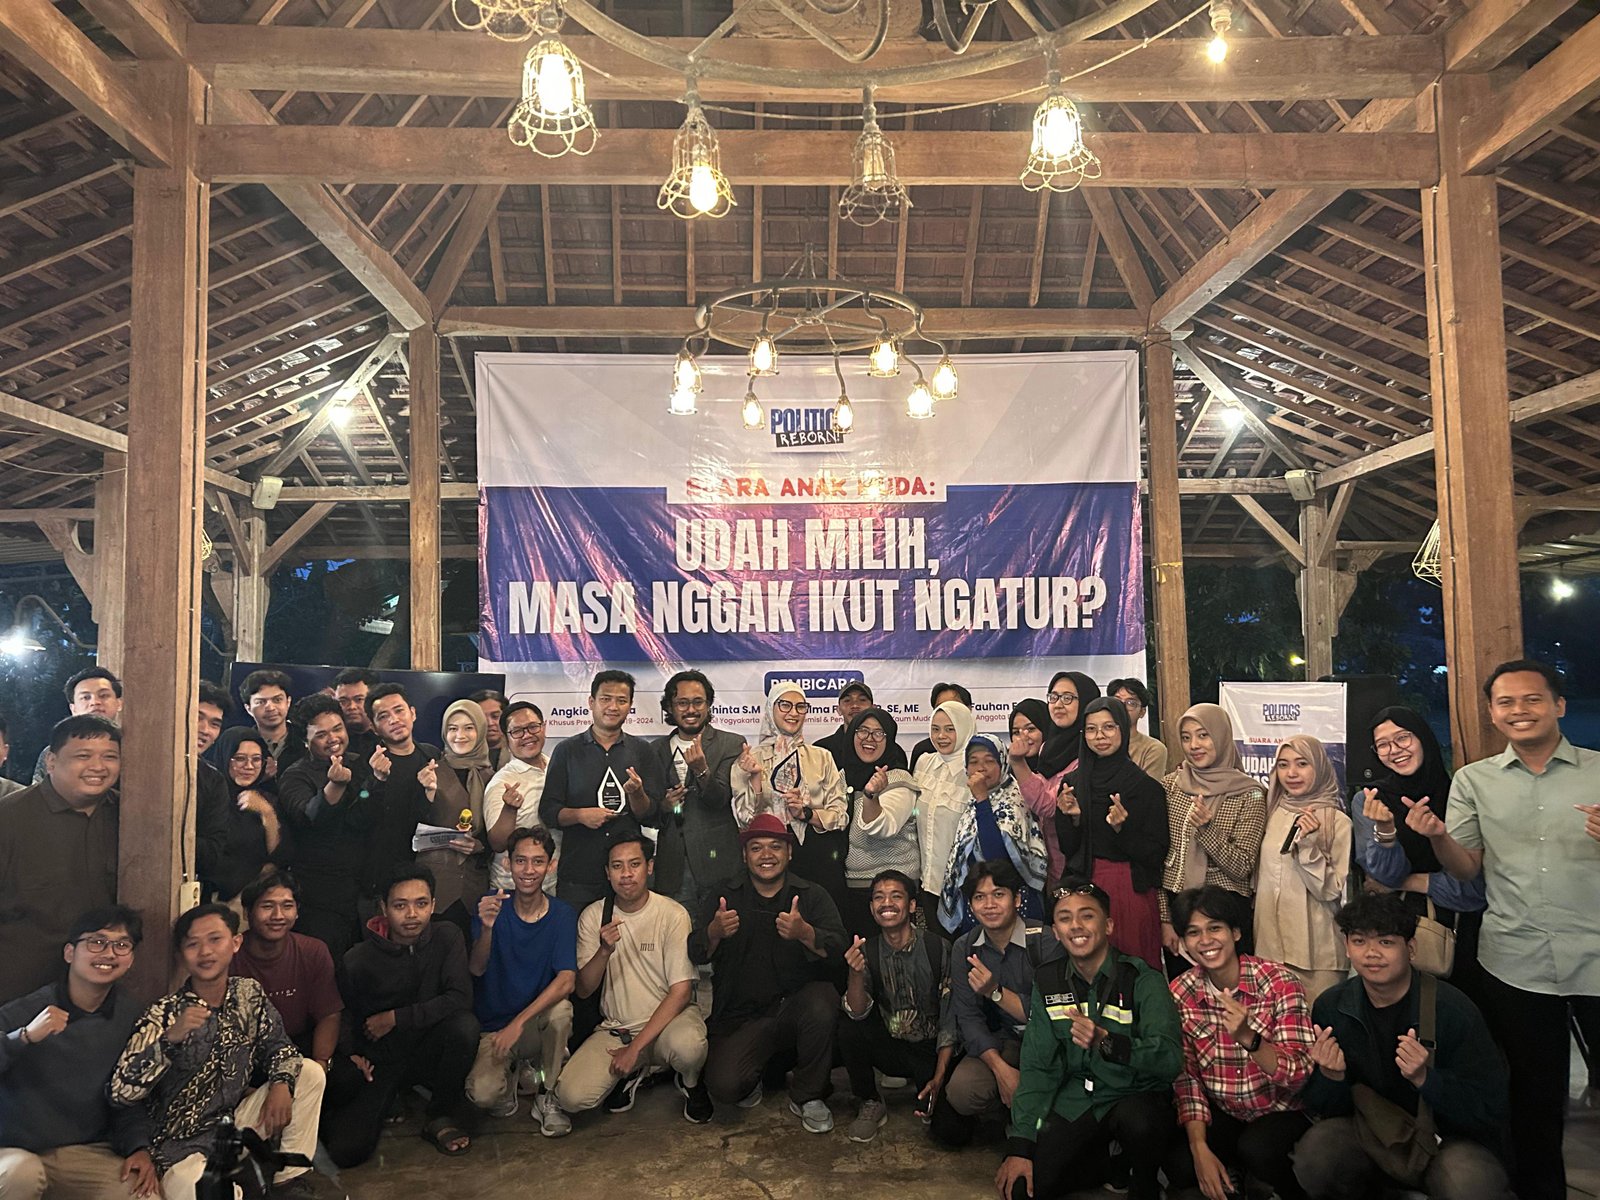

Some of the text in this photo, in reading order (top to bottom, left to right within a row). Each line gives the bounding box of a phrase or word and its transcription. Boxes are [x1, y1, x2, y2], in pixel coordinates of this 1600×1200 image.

[770, 408, 838, 434] POLITIC
[780, 431, 840, 446] REBORN!
[780, 477, 848, 497] ANAK
[857, 476, 935, 496] DA:
[676, 517, 939, 575] UDAH MILIH,
[508, 576, 1106, 634] MASA NGGAK IKUT NGATUR?
[551, 706, 589, 718] Angkie
[710, 705, 740, 714] hinta
[887, 704, 902, 714] SE,
[904, 704, 919, 712] ME
[1263, 704, 1300, 716] POLITICS
[549, 718, 575, 726] Khusus
[720, 717, 760, 726] Yogyakarta
[976, 714, 1006, 723] Anggota
